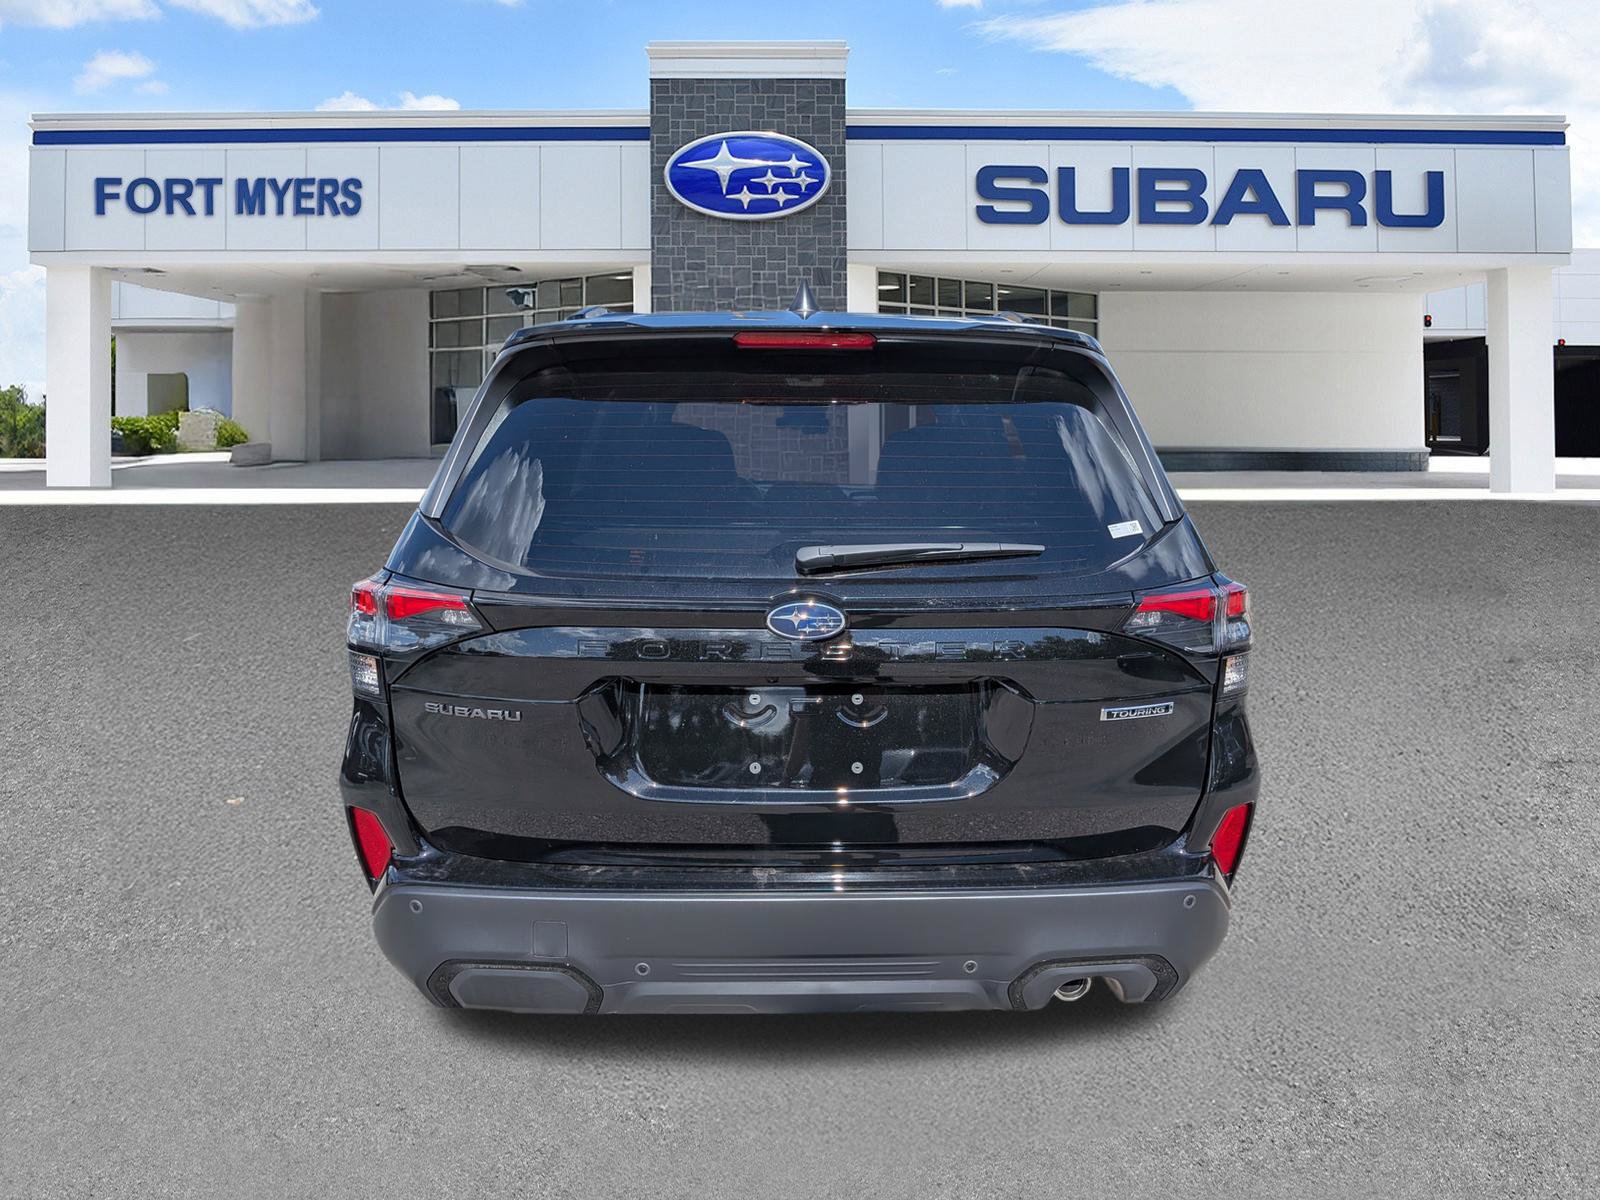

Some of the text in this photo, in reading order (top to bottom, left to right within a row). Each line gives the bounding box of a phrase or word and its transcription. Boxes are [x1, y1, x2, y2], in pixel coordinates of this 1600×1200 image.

[95, 177, 362, 216] FORT MYERS
[975, 165, 1445, 228] SUBARU
[577, 639, 1026, 661] FORESTER
[424, 702, 521, 722] SUBARU
[1111, 706, 1166, 719] TOURING
